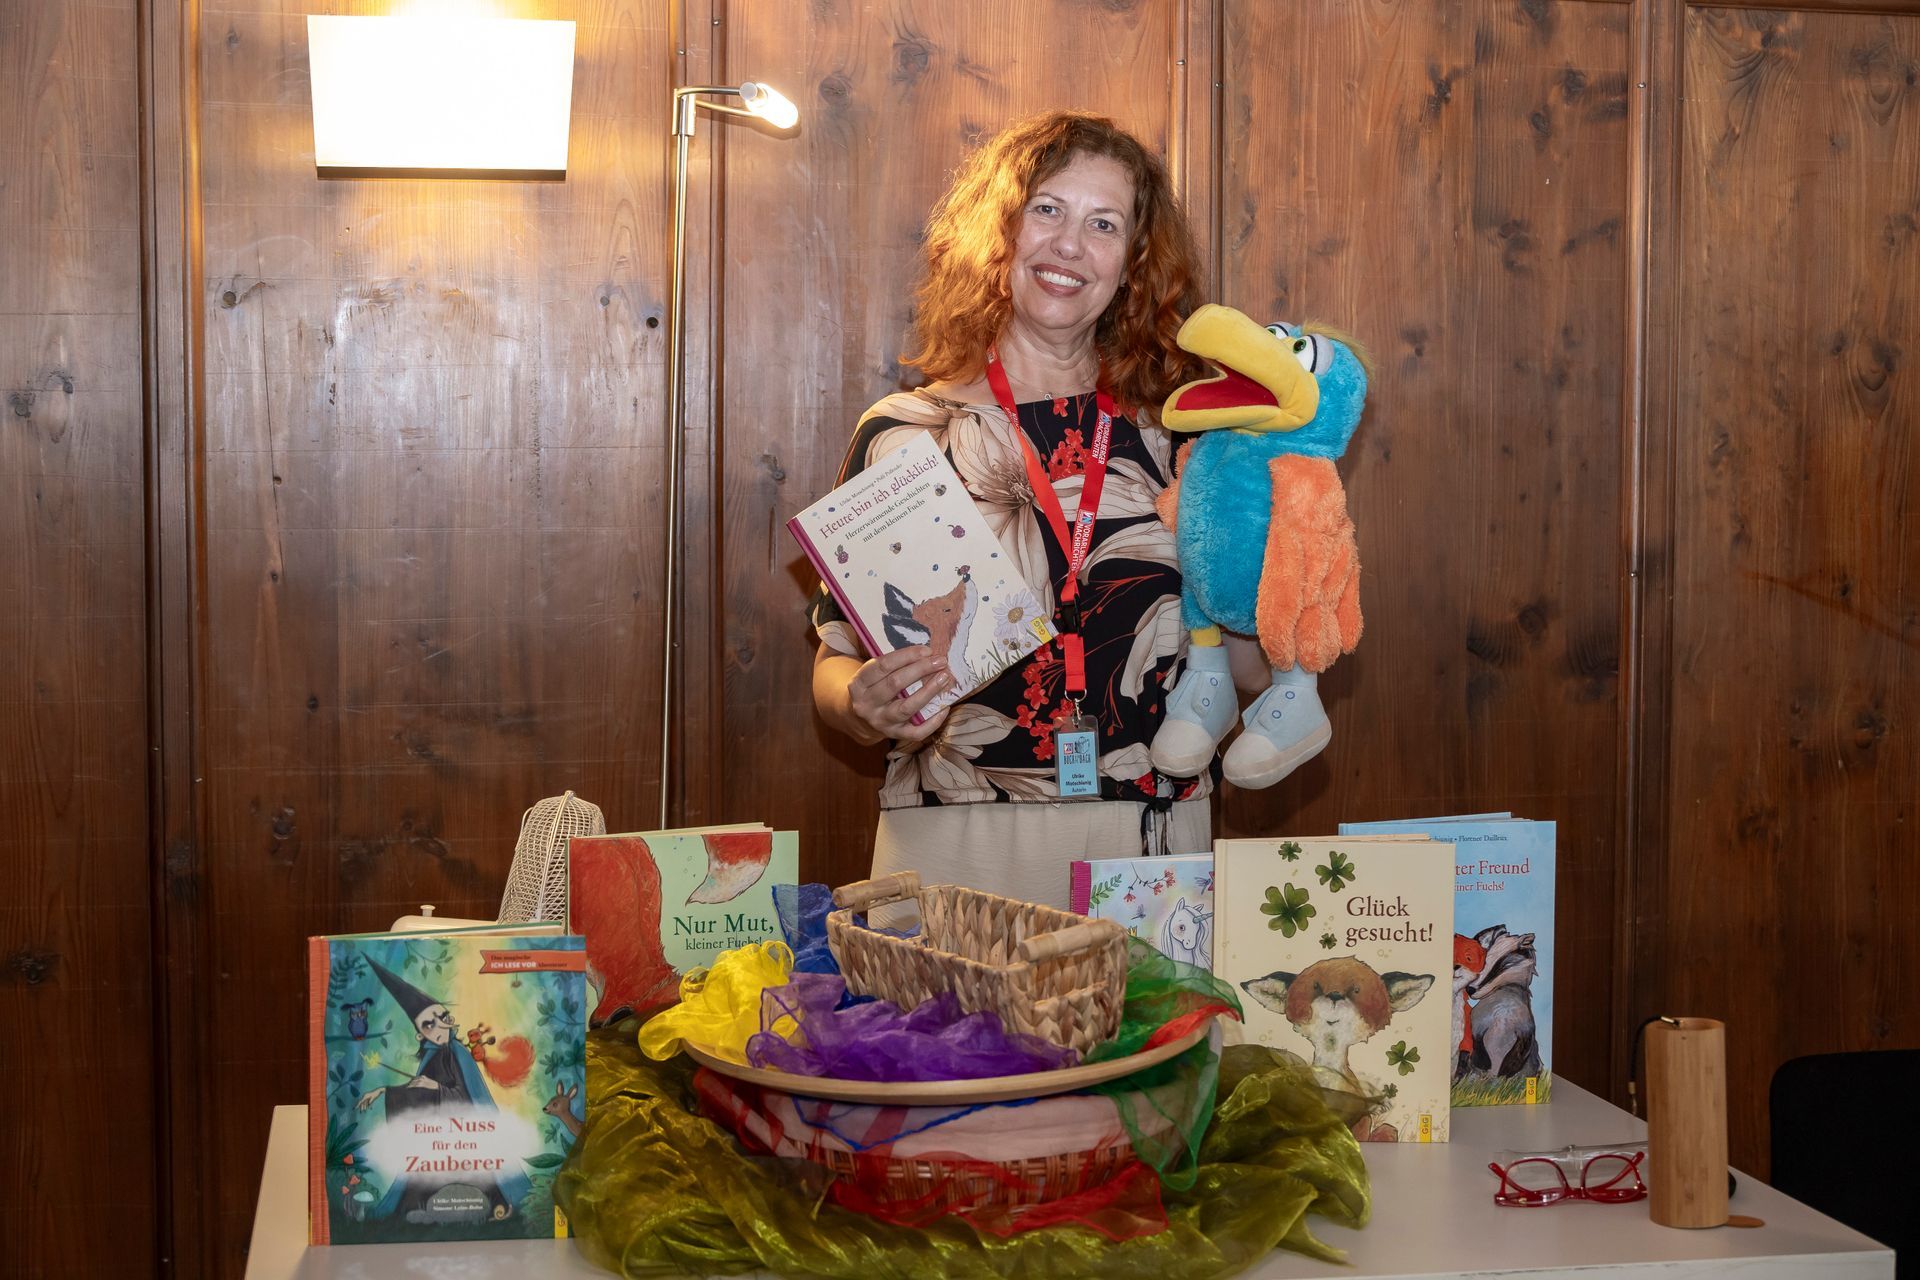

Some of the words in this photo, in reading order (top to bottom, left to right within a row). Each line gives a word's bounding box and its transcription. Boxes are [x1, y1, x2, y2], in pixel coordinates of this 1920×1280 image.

[1092, 420, 1104, 458] NACHRICHTEN
[1098, 424, 1110, 465] VORARLBERGER
[820, 512, 855, 539] Heute
[851, 501, 872, 517] bin
[872, 489, 891, 505] ich
[890, 454, 939, 495] glücklich!
[845, 504, 895, 540] Herzerwärmende
[894, 482, 931, 507] Geschichten
[863, 532, 874, 543] mit
[873, 525, 887, 538] dem
[885, 511, 908, 528] kleinen
[907, 499, 926, 513] Fuchs
[1071, 523, 1084, 571] NACHRICHTEN
[1479, 858, 1530, 875] Freund
[1476, 881, 1504, 891] Fuchs!
[1346, 895, 1410, 917] Glück
[673, 915, 717, 935] Nur
[724, 913, 774, 934] Mut,
[1345, 921, 1433, 947] gesucht!
[685, 938, 724, 950] kleiner
[414, 1122, 442, 1133] Eine
[448, 1117, 496, 1133] Nuss
[432, 1140, 451, 1150] für
[454, 1140, 478, 1150] den
[405, 1155, 505, 1173] Zauberer
